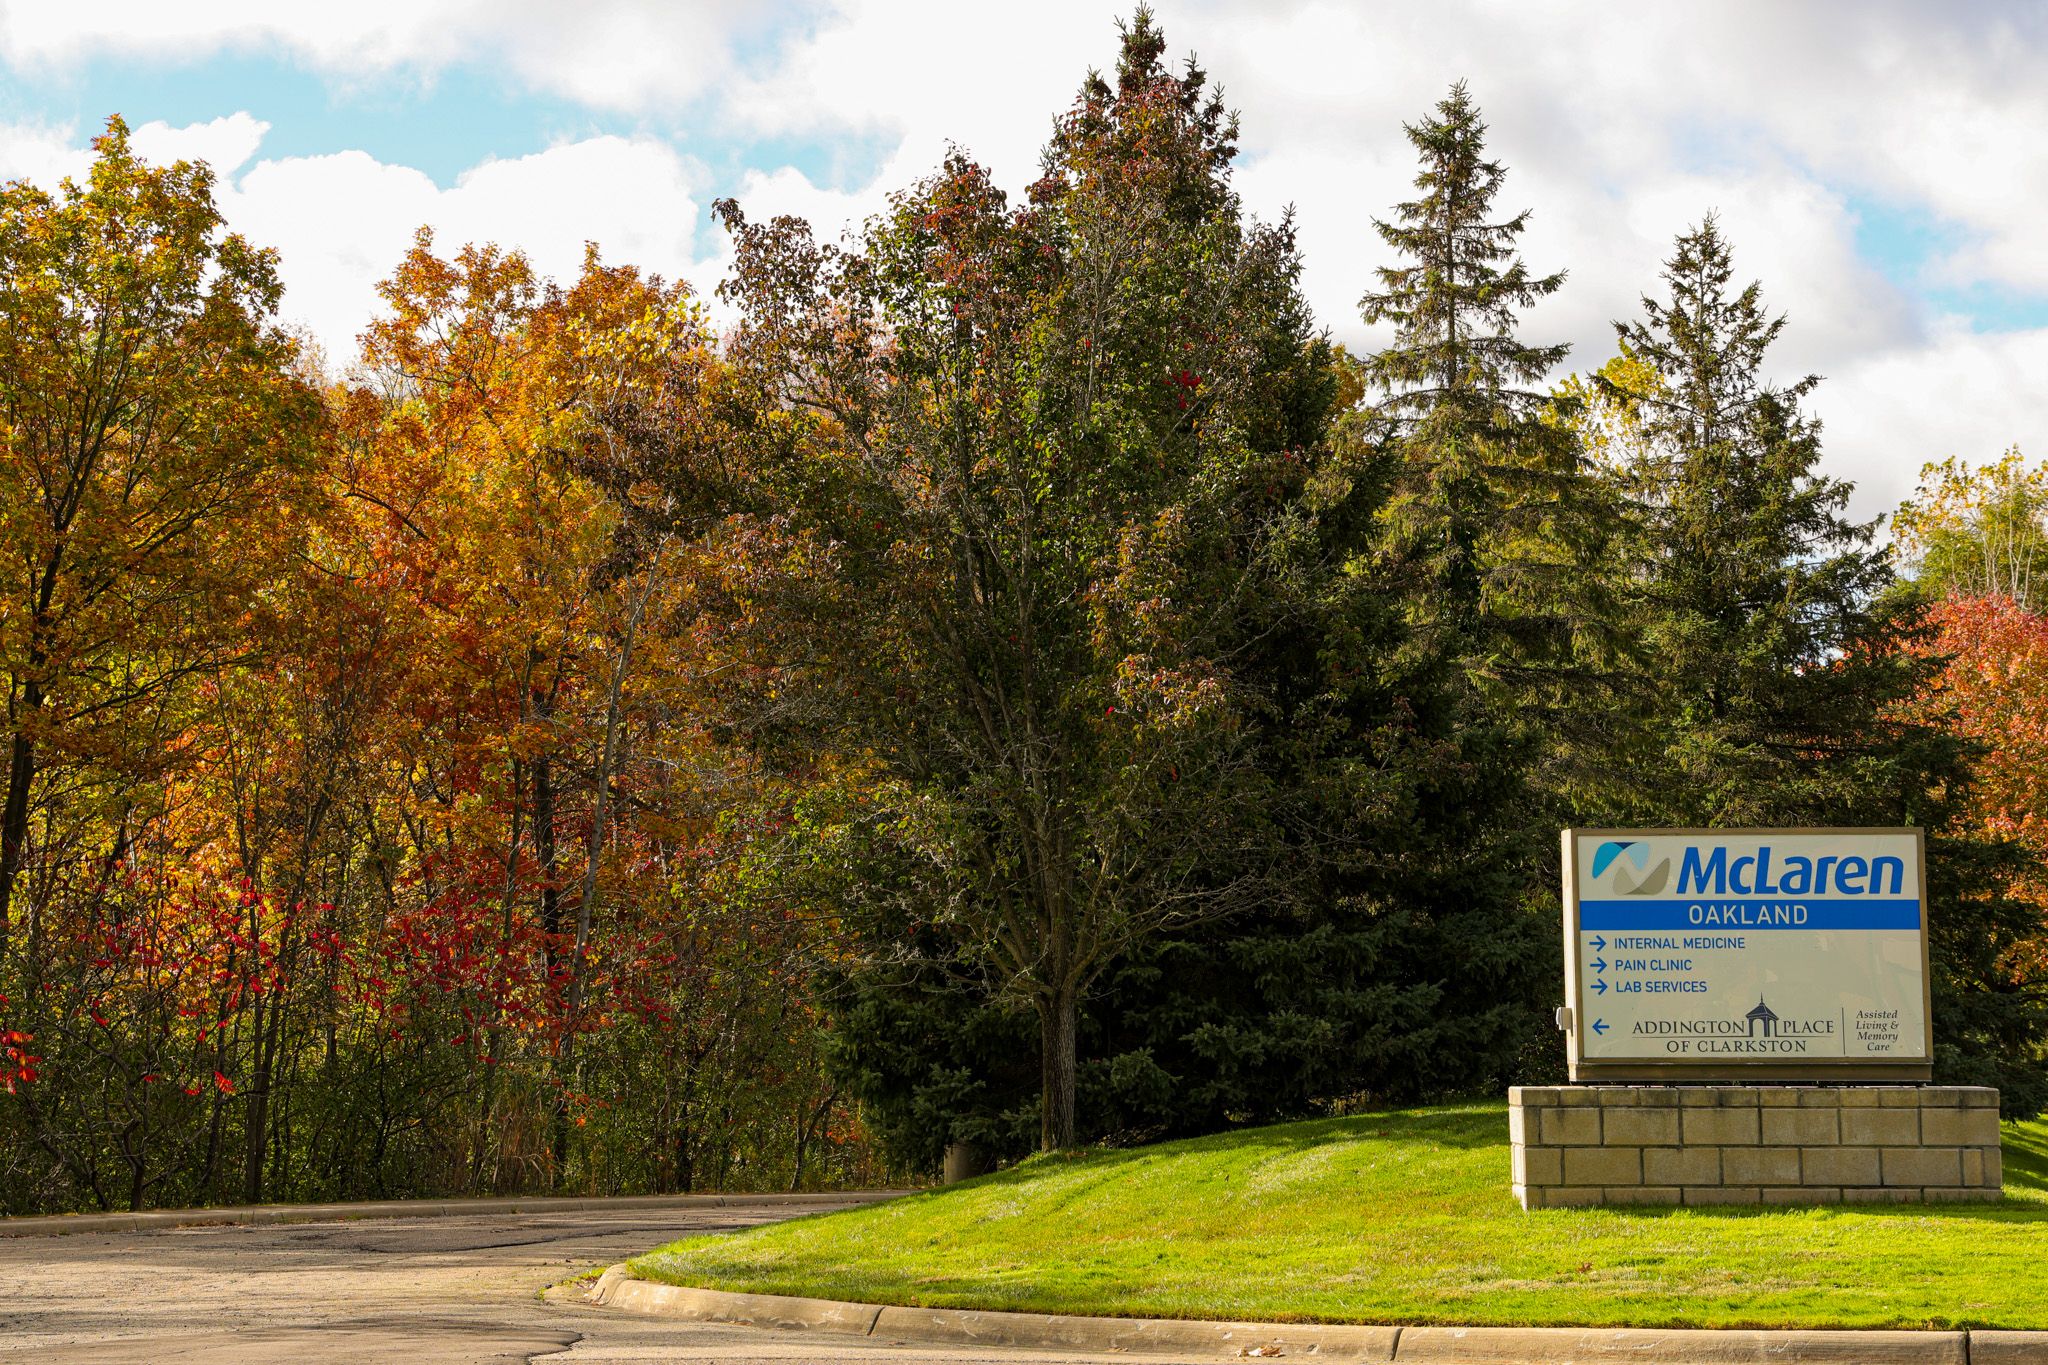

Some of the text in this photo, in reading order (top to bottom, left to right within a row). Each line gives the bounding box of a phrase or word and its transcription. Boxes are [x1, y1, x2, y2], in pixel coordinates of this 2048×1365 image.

[1676, 847, 1904, 895] McLaren
[1688, 904, 1808, 925] OAKLAND
[1614, 937, 1746, 949] INTERNAL MEDICINE
[1615, 959, 1692, 971] PAIN CLINIC
[1616, 981, 1707, 993] LAB SERVICES
[1856, 1009, 1898, 1019] Assisted
[1632, 1020, 1834, 1034] ADDINGTON PLACE
[1856, 1021, 1899, 1032] Living &
[1857, 1032, 1898, 1043] Memory
[1666, 1040, 1807, 1053] OF CLARKSTON
[1867, 1042, 1890, 1051] Care
